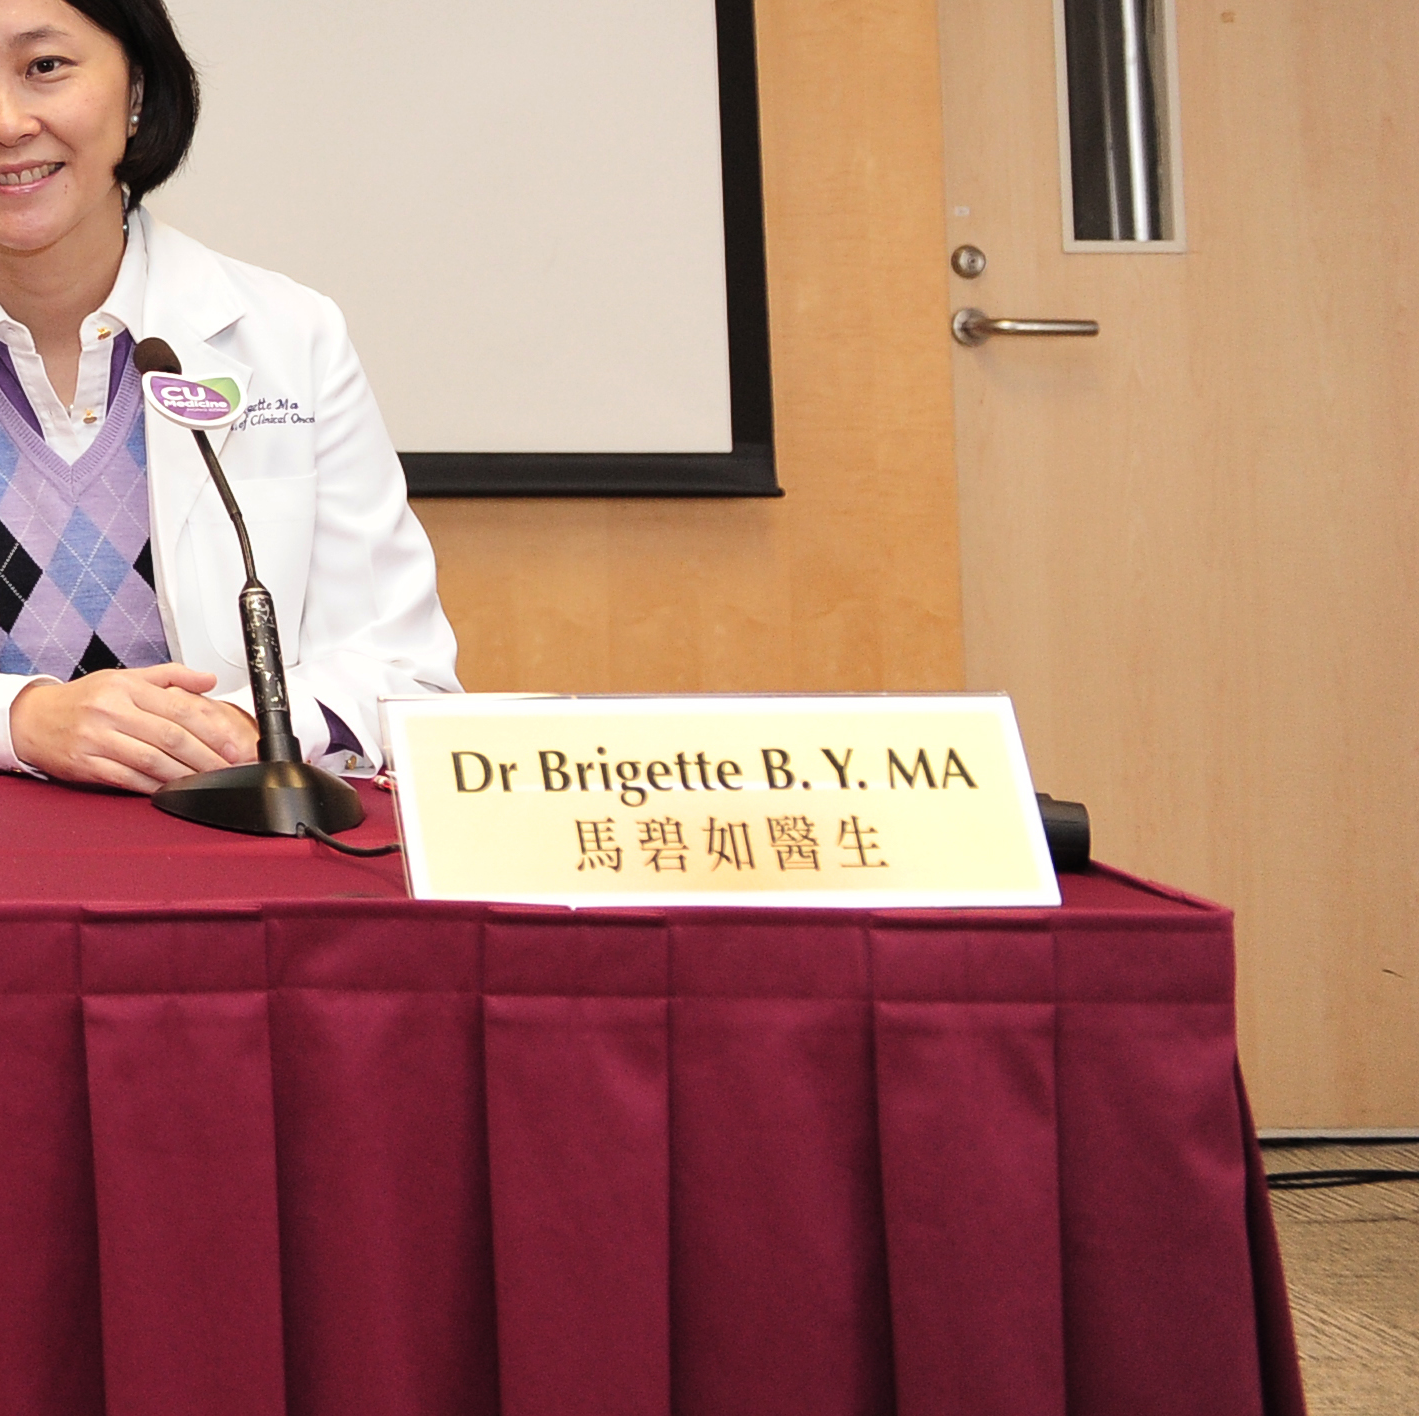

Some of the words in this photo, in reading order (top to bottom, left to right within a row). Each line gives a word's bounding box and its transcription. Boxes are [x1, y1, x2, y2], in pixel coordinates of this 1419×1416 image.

[161, 386, 206, 401] CU
[164, 399, 228, 408] Medicine
[451, 749, 518, 794] Dr
[539, 746, 743, 808] Brigette
[762, 747, 811, 790] B.
[821, 747, 868, 790] Y.
[887, 747, 979, 790] MA
[574, 814, 890, 873] 馬碧如醫生
